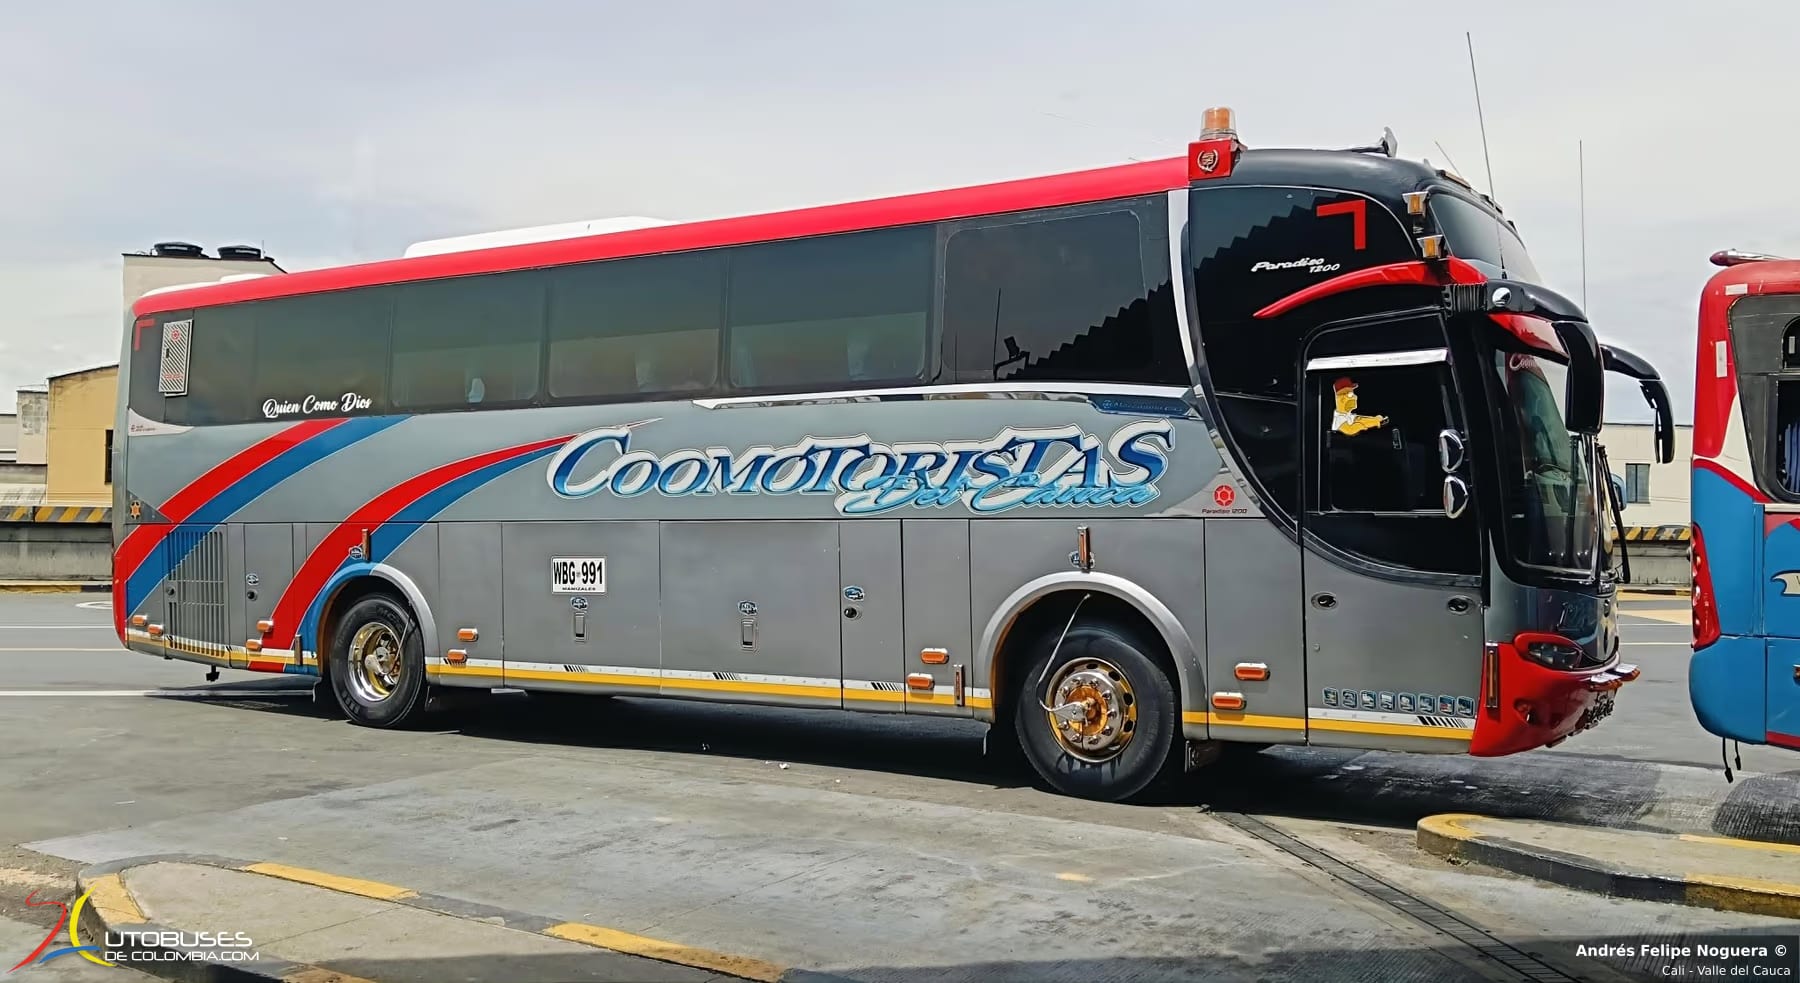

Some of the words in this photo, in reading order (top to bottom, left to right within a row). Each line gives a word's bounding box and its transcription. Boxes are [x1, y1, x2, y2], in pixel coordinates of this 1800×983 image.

[1251, 257, 1325, 272] Paradiso
[1309, 263, 1341, 273] 1200
[262, 398, 300, 418] Quien
[302, 394, 338, 414] Como
[340, 392, 372, 412] Dios
